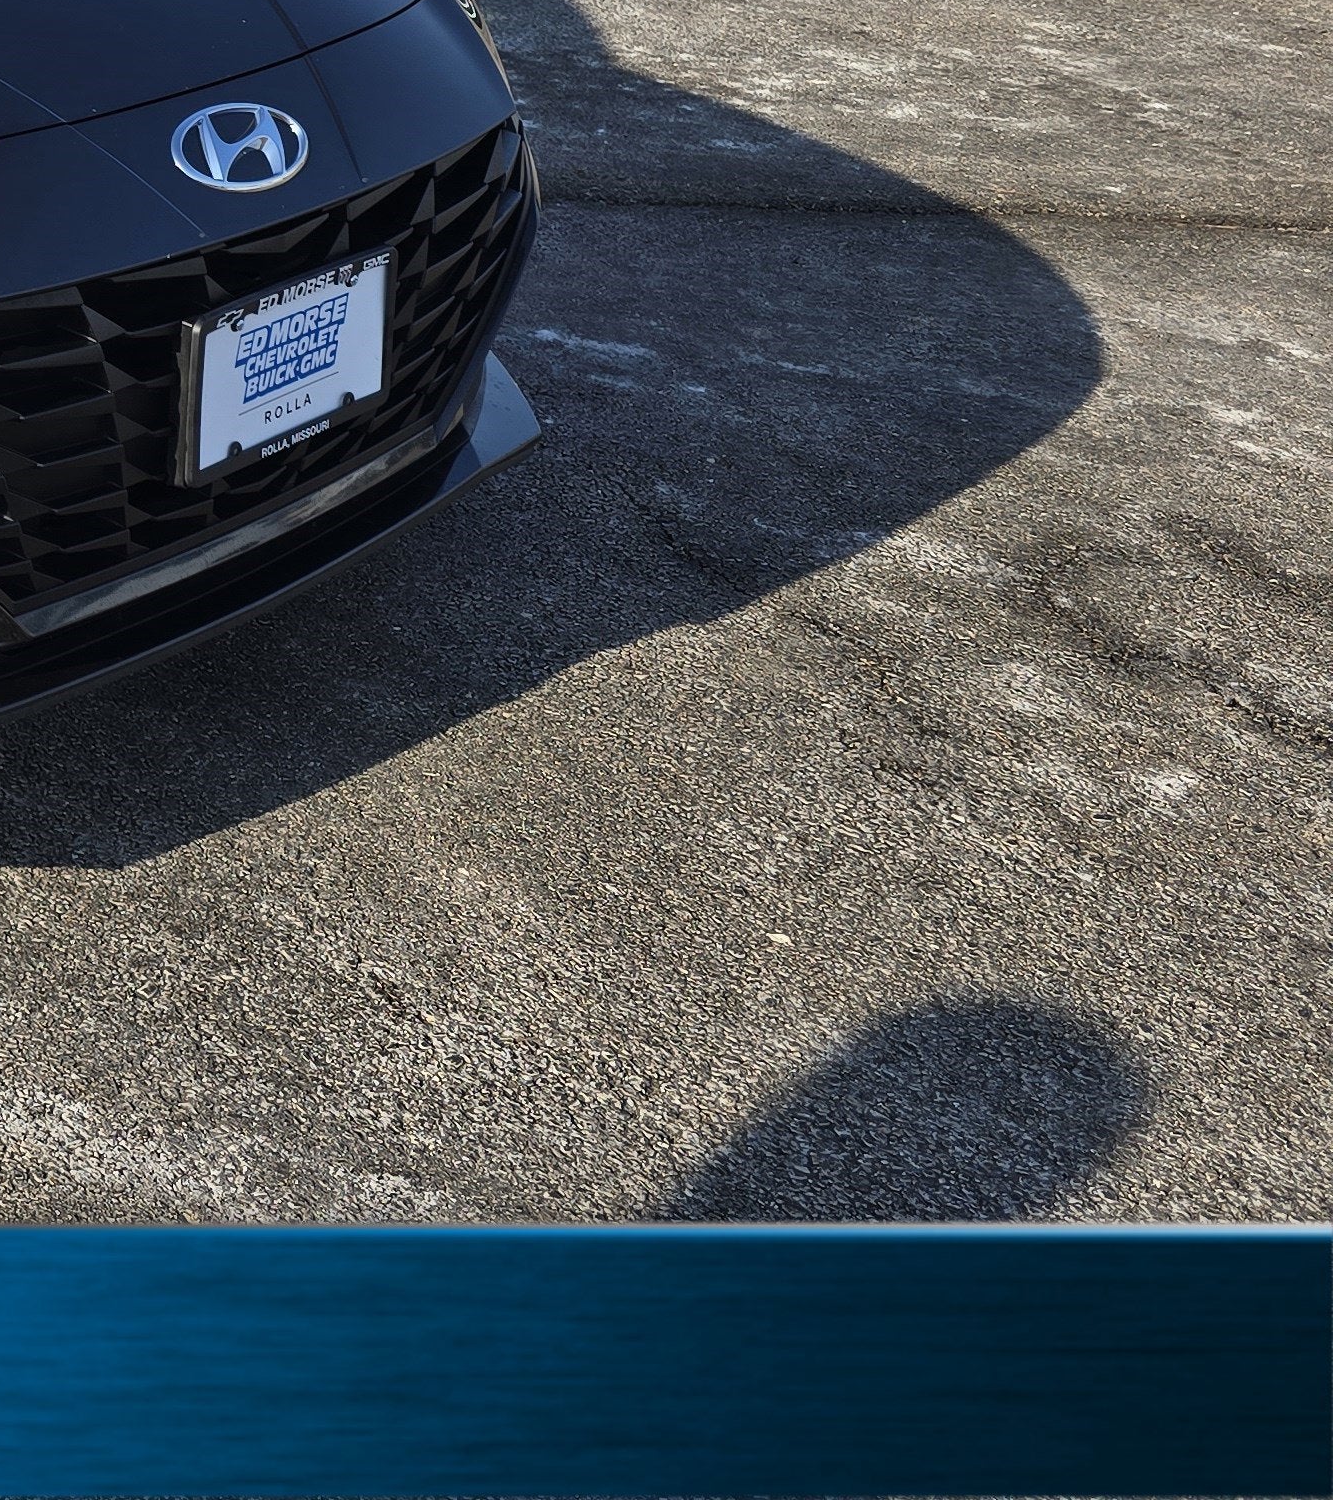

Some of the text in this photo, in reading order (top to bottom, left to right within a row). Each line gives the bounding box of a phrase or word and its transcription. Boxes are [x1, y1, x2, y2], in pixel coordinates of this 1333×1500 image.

[258, 253, 390, 315] ED MORSE GMC
[236, 295, 347, 362] ED MORSE
[264, 393, 311, 424] ROLLA
[291, 419, 330, 444] MISSOURI
